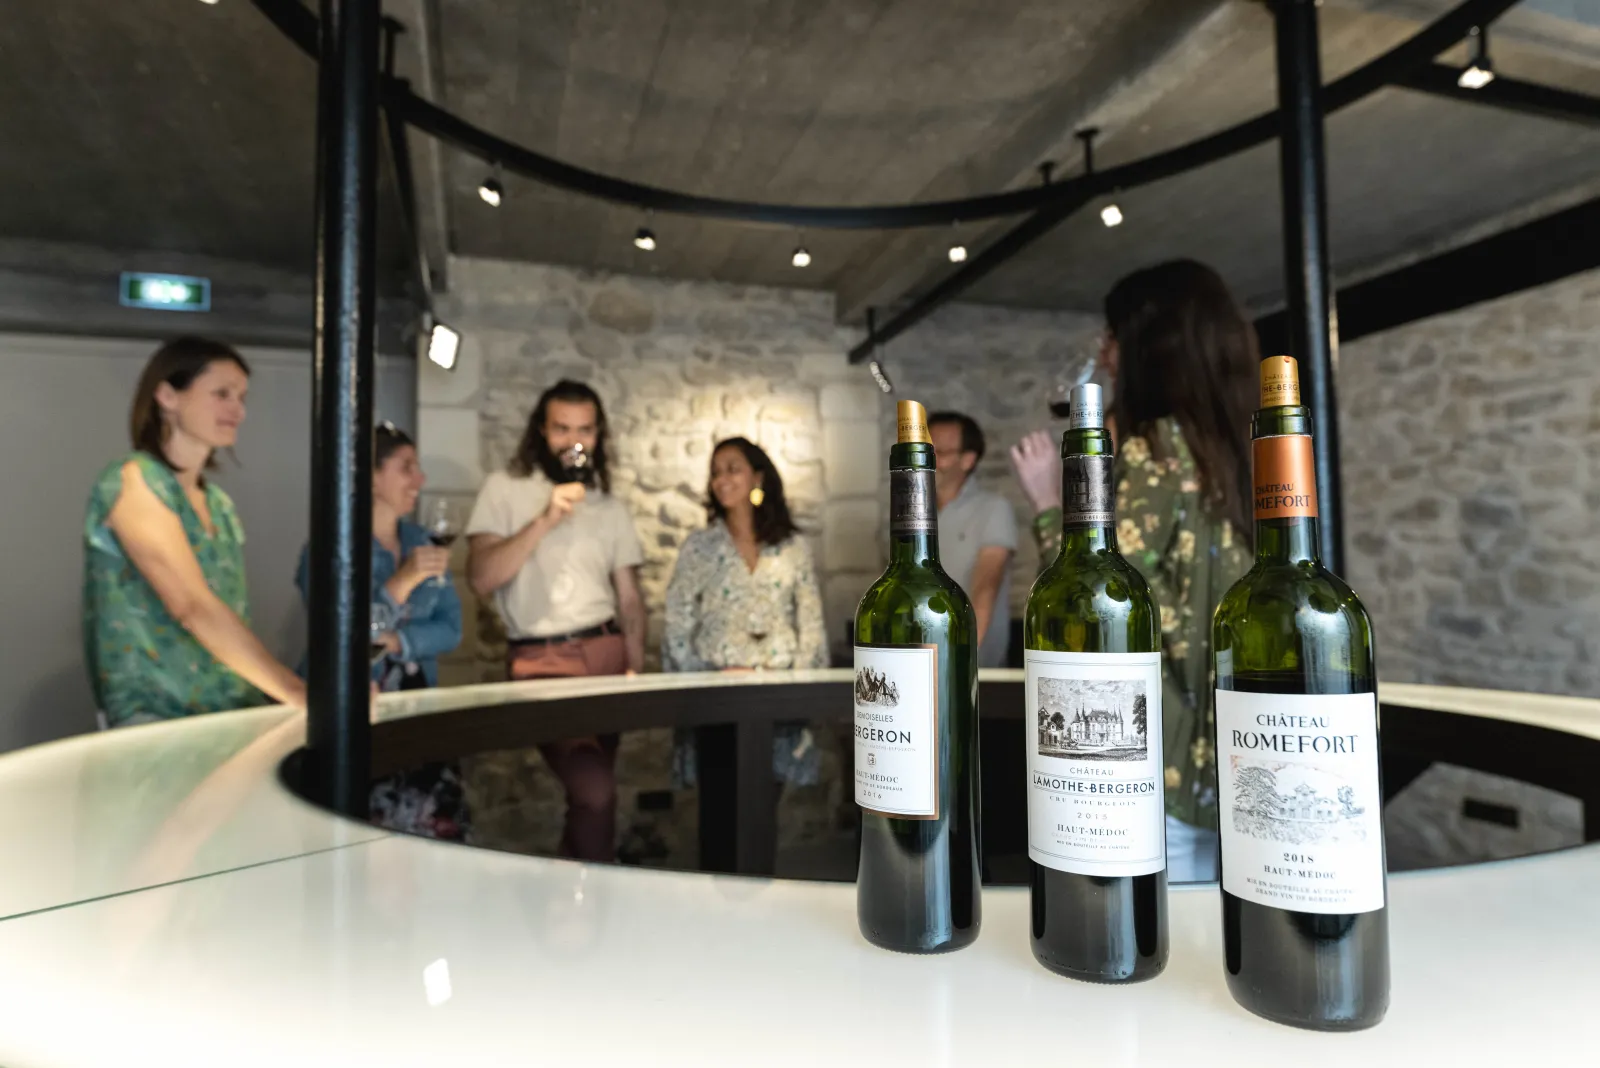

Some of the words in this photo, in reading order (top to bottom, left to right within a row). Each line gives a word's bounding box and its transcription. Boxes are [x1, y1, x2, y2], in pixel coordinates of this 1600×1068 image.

[1262, 383, 1298, 393] HE-BERG
[1256, 483, 1294, 494] CHÂTEAU
[857, 711, 894, 722] DEMOISELLES
[1256, 713, 1330, 728] CHÂTEAU
[854, 724, 911, 744] ERGERON
[1232, 730, 1358, 753] ROMEFORT
[1070, 767, 1114, 776] CHÂTEAU
[1033, 774, 1155, 793] LAMOTHE-BERGERON
[863, 790, 882, 799] 2016
[1049, 795, 1067, 803] CRU
[1057, 823, 1128, 836] HAUT-MÉDOC
[1283, 852, 1314, 863] 2018
